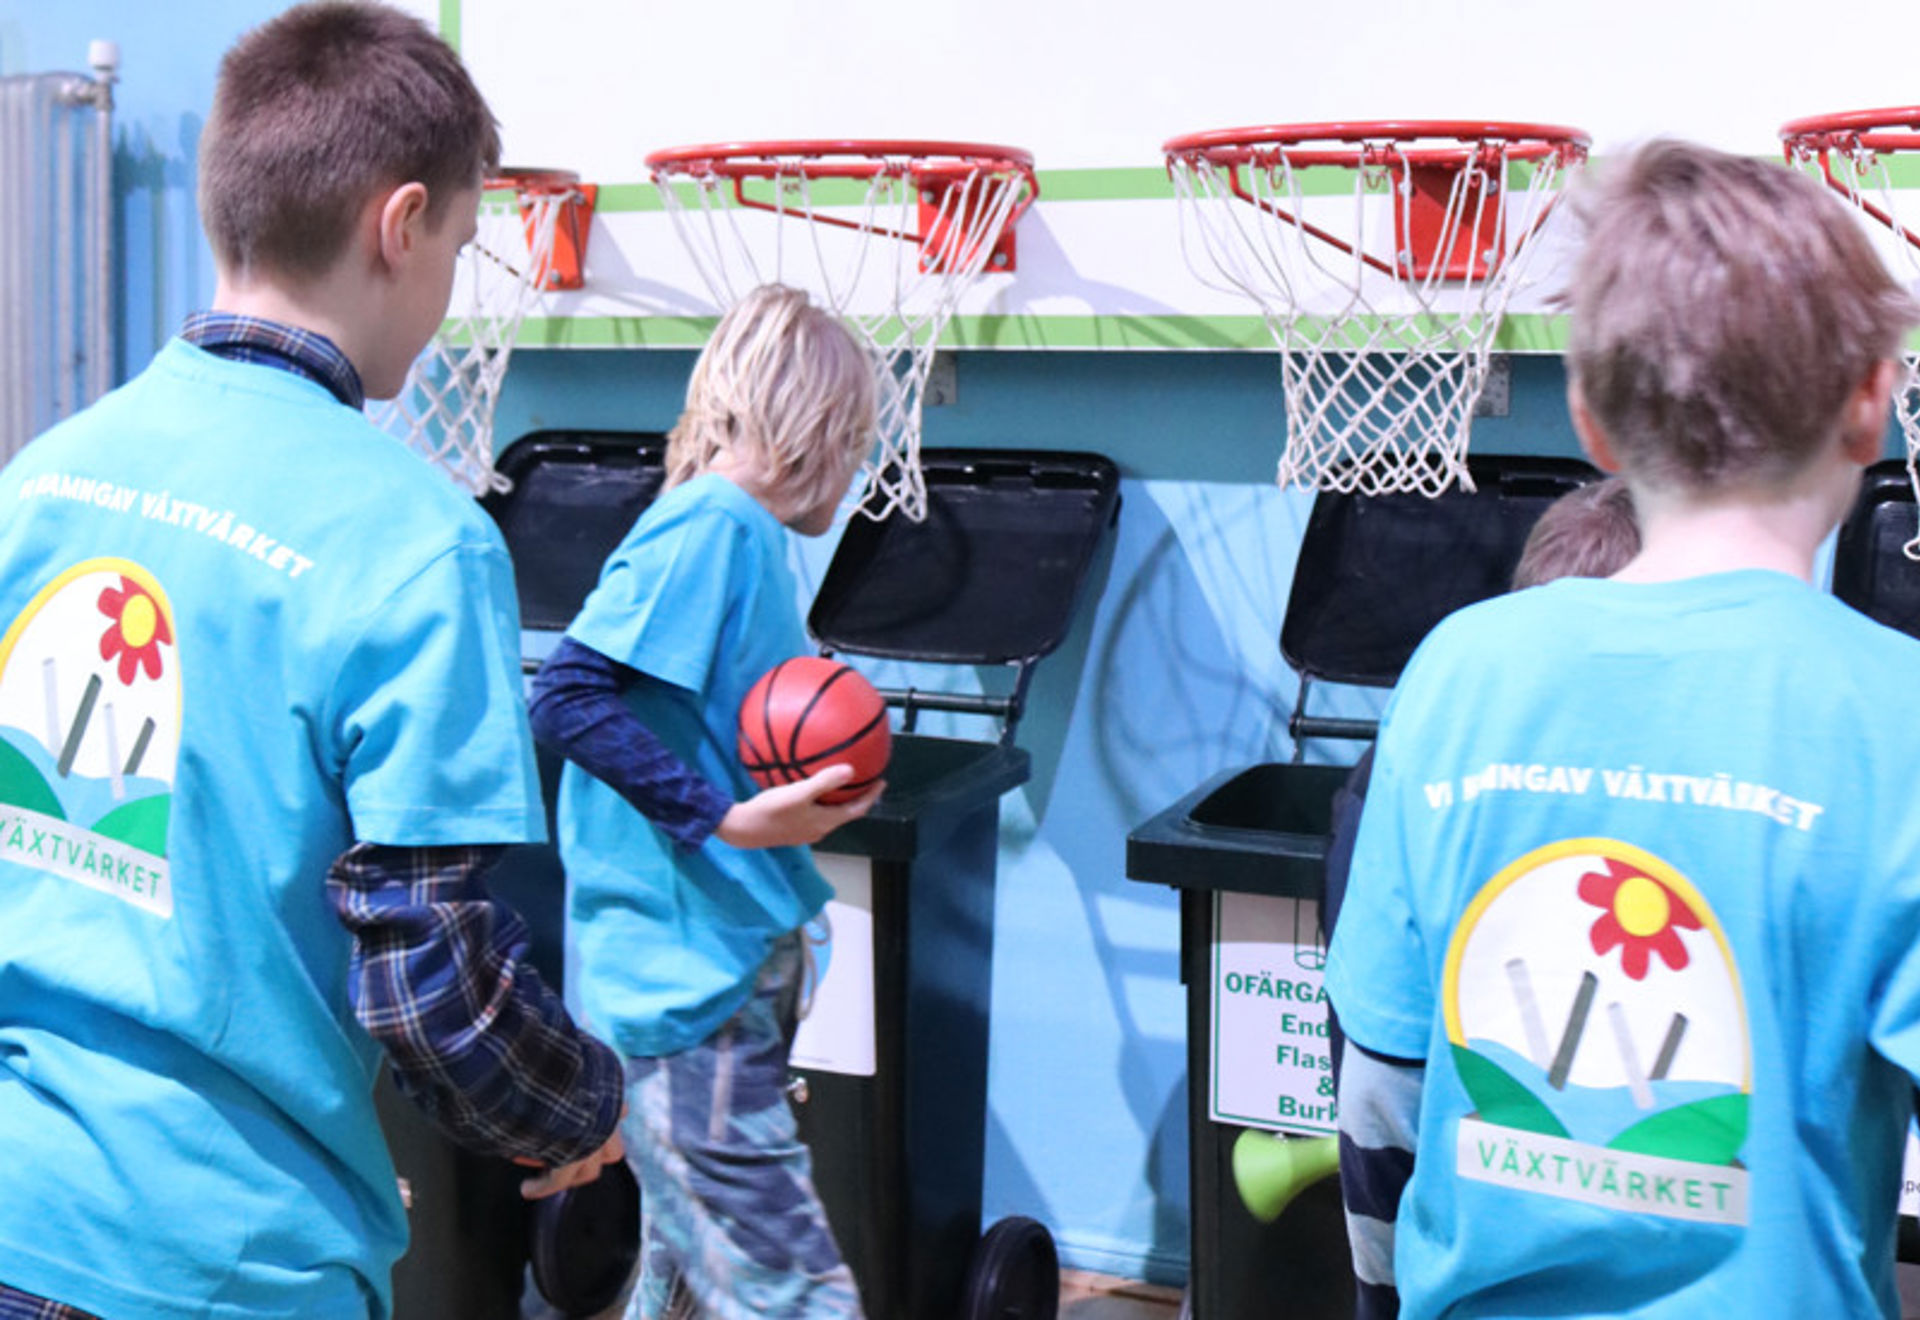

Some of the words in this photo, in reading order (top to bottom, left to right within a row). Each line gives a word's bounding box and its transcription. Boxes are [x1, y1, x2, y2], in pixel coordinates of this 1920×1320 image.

[141, 489, 315, 578] VÄXTVÄRKET
[1602, 764, 1824, 831] VÄXTVÄRKET
[1316, 1075, 1335, 1097] &
[1478, 1138, 1732, 1211] VÄXTVÄRKET
